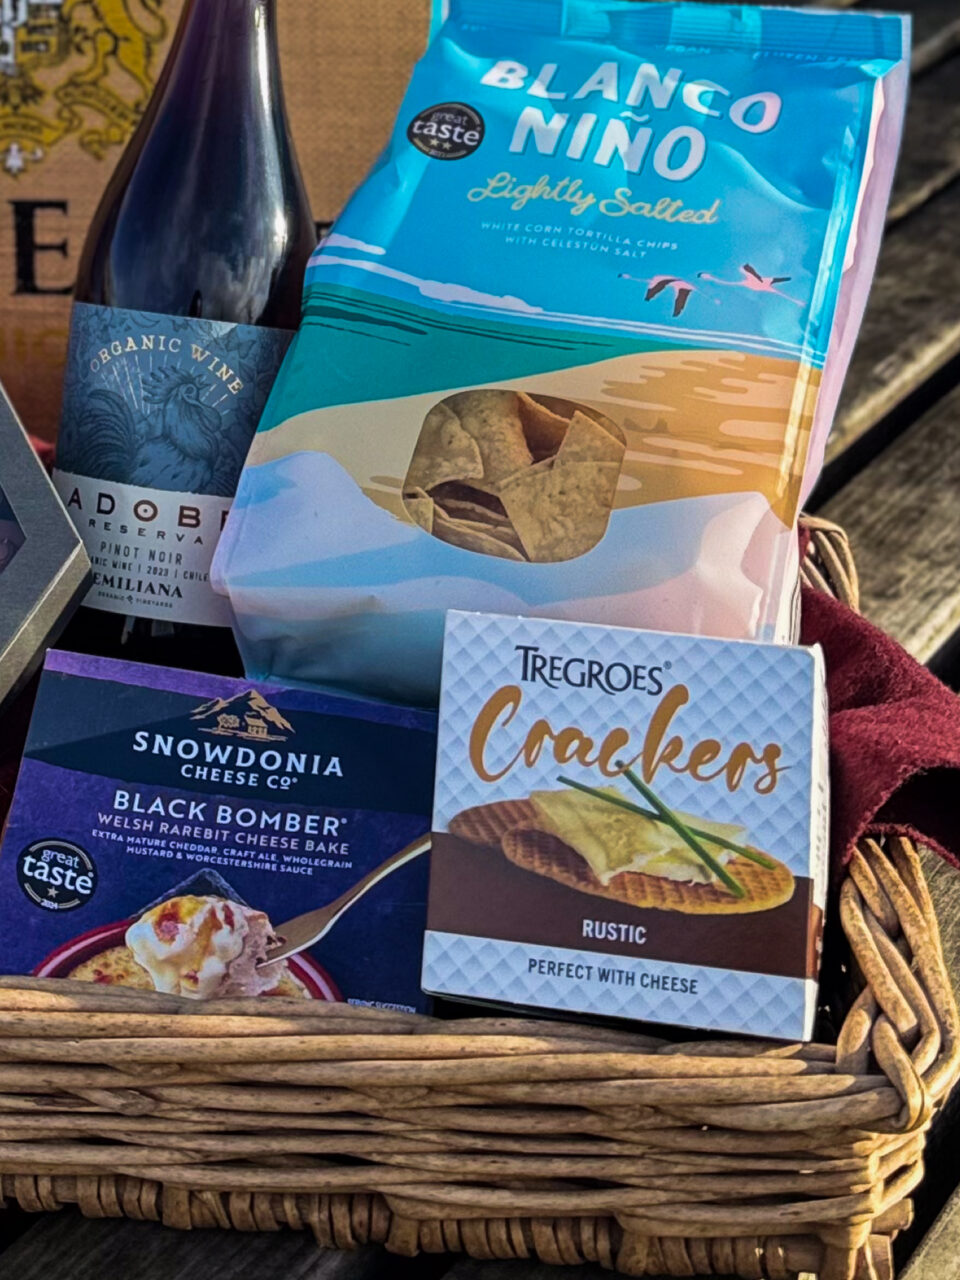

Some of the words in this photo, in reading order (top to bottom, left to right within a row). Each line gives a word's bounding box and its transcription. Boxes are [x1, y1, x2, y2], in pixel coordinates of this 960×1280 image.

[479, 59, 782, 135] BLANCO
[412, 120, 480, 146] taste
[508, 105, 707, 182] NIÑO
[467, 171, 597, 215] Lightly
[598, 187, 720, 225] Salted
[481, 221, 519, 231] WHITE
[524, 223, 562, 234] CORN
[568, 226, 632, 246] TORTILLA
[636, 239, 679, 251] CHIPS
[505, 235, 538, 246] WITH
[614, 247, 648, 258] SALT
[90, 334, 182, 372] ORGANIC
[190, 343, 245, 396] WINE
[88, 519, 203, 545] RESERVA
[100, 541, 140, 559] PINOT
[148, 549, 183, 565] NOIR
[92, 572, 183, 598] EMILIANA
[132, 731, 344, 777] SNOWDONIA
[468, 683, 792, 795] Crackers
[180, 764, 260, 787] CHEESE
[113, 790, 208, 822] BLACK
[216, 805, 341, 837] BOMBER
[91, 829, 124, 842] EXTRA
[126, 835, 167, 848] MATURE
[223, 847, 256, 859] CRAFT
[282, 854, 353, 869] WHOLEGRAIN
[97, 812, 154, 833] WELSH
[159, 821, 231, 842] RAREBIT
[234, 831, 300, 850] CHEESE
[304, 840, 350, 855] BAKE
[23, 855, 93, 895] taste
[41, 849, 80, 869] great
[126, 845, 174, 858] MUSTARD
[186, 854, 278, 871] WORCESTERSHIRE
[279, 864, 313, 876] SAUCE
[581, 919, 647, 945] RUSTIC
[527, 958, 593, 982] PERFECT
[597, 966, 636, 987] WITH
[640, 972, 699, 995] CHEESE
